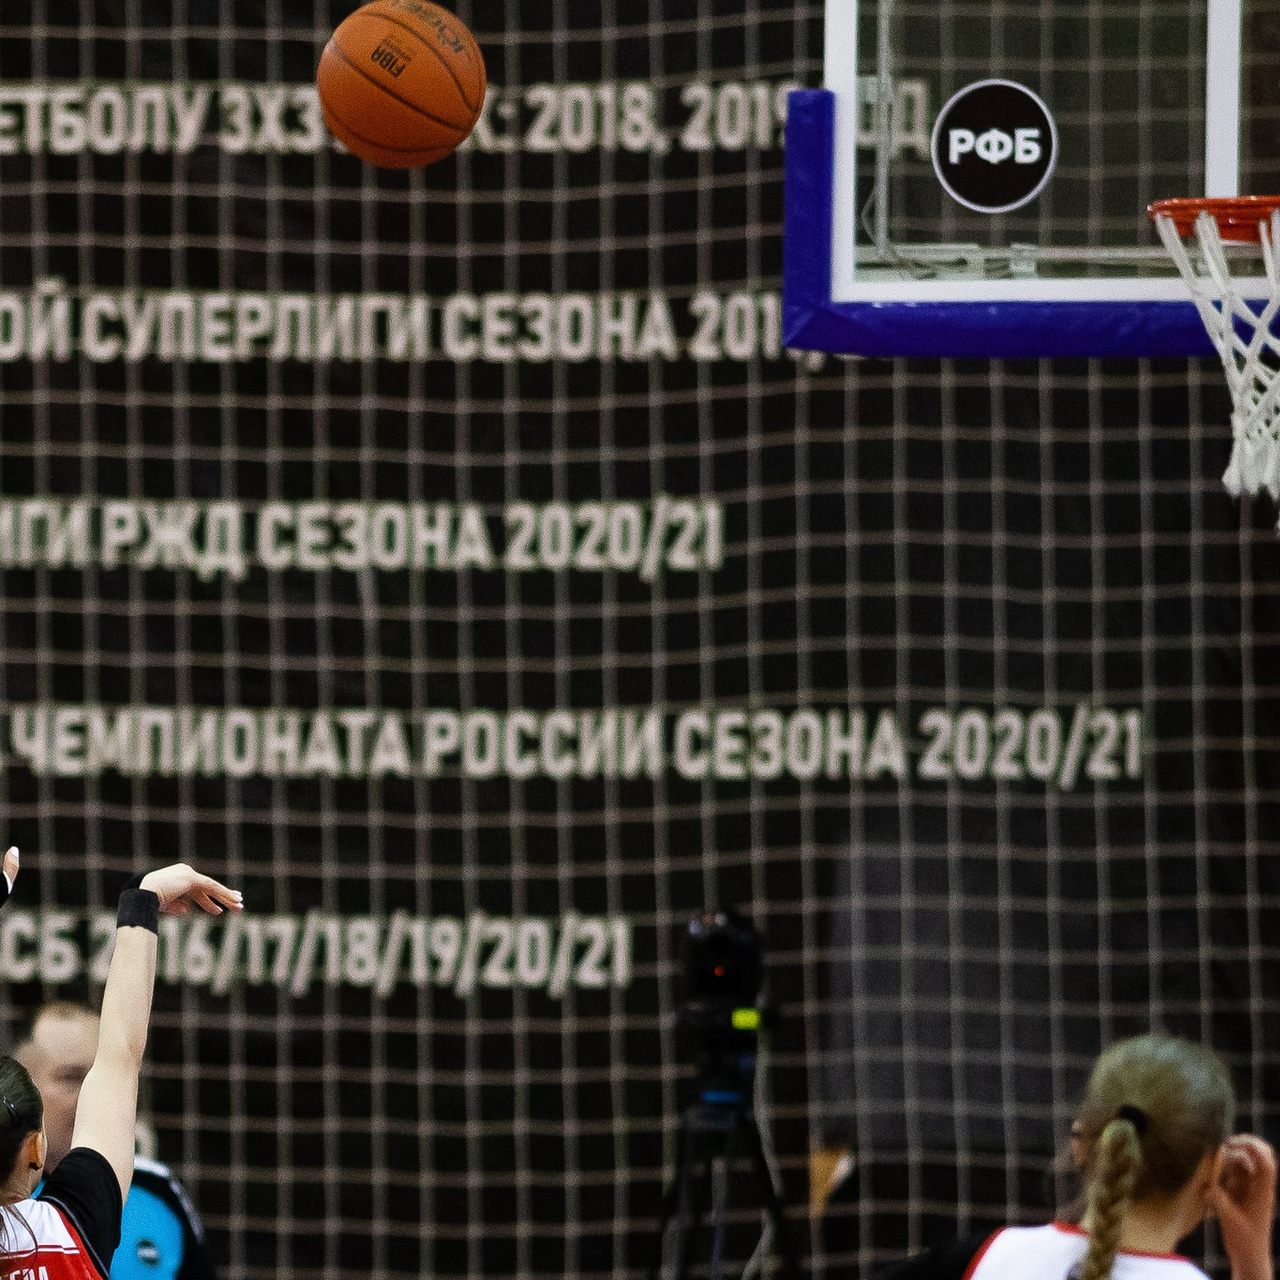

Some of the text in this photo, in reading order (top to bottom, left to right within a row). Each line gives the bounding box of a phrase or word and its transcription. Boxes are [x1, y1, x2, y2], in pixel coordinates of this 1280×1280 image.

[370, 44, 407, 79] FIBA
[526, 82, 668, 156] 2018,
[948, 128, 1043, 165] РФБ
[82, 291, 428, 361] СУПЕРЛИГИ
[444, 294, 676, 361] СЕЗОНА
[102, 501, 245, 577] РЖД
[258, 502, 491, 570] СЕЗОНА
[505, 496, 723, 579] 2020/21
[12, 707, 410, 777] ЧЕМПИОНАТА
[422, 710, 663, 778] РОССИИ
[675, 710, 906, 778] СЕЗОНА
[920, 704, 1142, 788] 2020/21
[87, 907, 630, 993] 216/17/18/19/20/21
